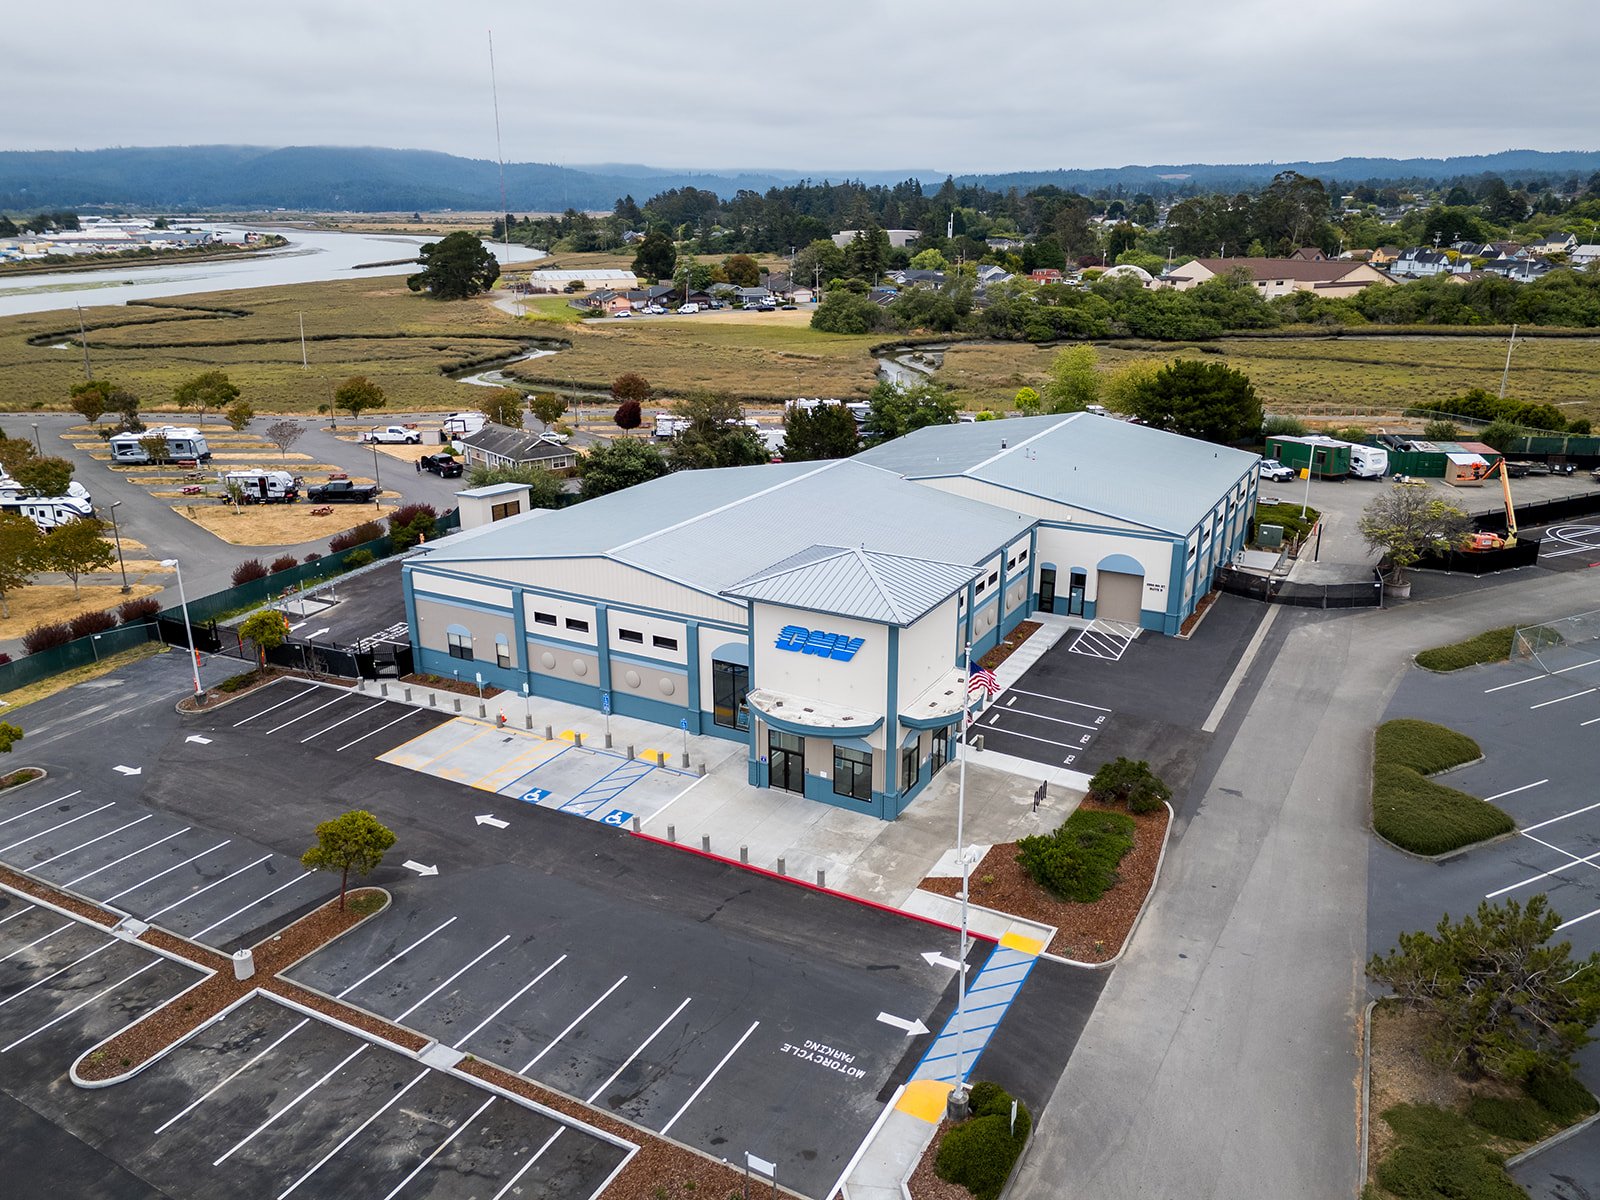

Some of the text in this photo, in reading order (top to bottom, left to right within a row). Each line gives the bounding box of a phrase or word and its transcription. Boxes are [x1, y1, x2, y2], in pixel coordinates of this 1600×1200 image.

[774, 625, 866, 662] DMV
[780, 1043, 866, 1079] MOTORCYCLE
[803, 1039, 856, 1064] PARKING
